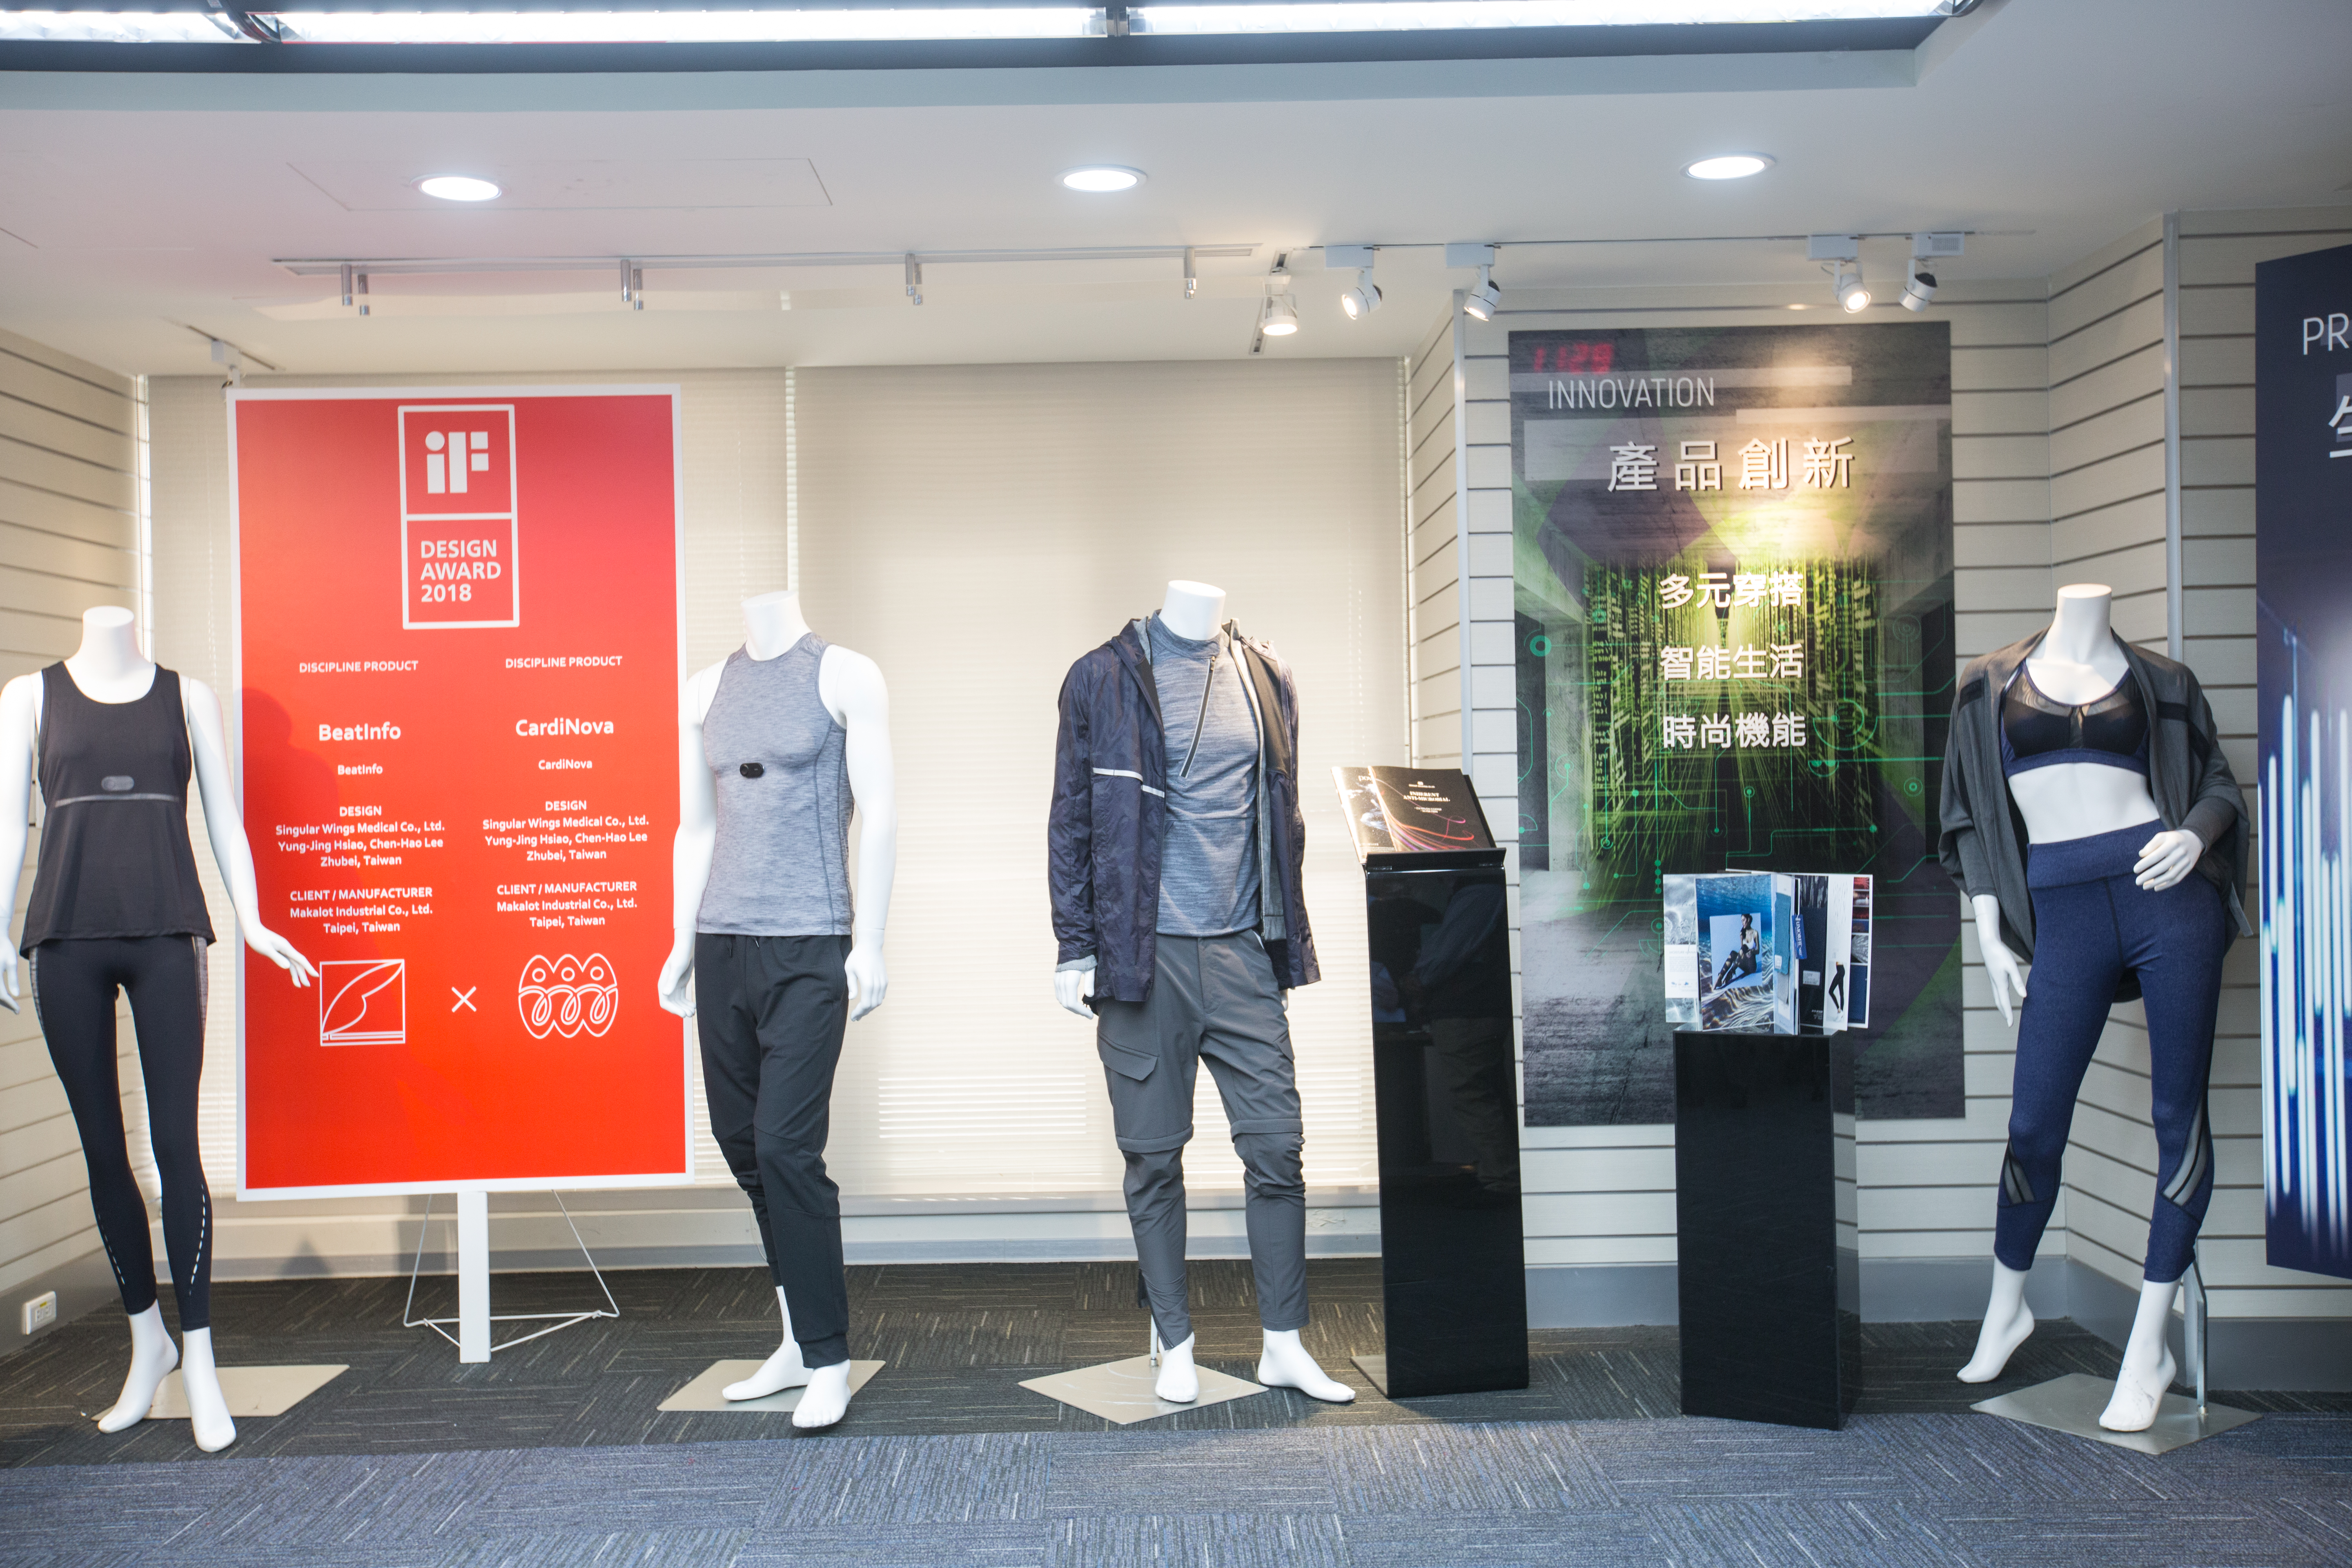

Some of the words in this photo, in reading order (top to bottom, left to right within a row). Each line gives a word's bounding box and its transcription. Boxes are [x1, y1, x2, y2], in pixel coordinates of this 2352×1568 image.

[2303, 312, 2350, 355] PR
[1549, 376, 1714, 409] INNOVATION
[1608, 436, 1854, 492] 產品創新
[421, 539, 497, 558] DESIGN
[420, 561, 501, 581] AWARD
[421, 584, 472, 603] 2018
[1659, 571, 1804, 610] 多元穿搭
[299, 662, 361, 673] DISCIPLINE
[364, 660, 419, 671] PRODUCT
[506, 657, 566, 668] DISCIPLINE
[569, 656, 623, 667] PRODUCT
[1659, 643, 1804, 681] 智能生活
[318, 721, 401, 741] BeatInfo
[515, 717, 614, 737] CardiNova
[1662, 711, 1807, 749] 時尚機能
[338, 763, 383, 775] BeatInfo
[538, 758, 592, 770] CardiNova
[340, 806, 382, 817] DESIGN
[546, 800, 587, 811] DESIGN
[276, 824, 319, 837] Singular
[322, 823, 355, 836] Wings
[357, 822, 397, 833] Medical
[400, 822, 421, 833] Co.,
[424, 820, 445, 831] Ltd.
[483, 819, 526, 832] Singular
[528, 817, 560, 831] Wings
[563, 816, 602, 828] Medical
[605, 816, 626, 828] Co.,
[628, 815, 649, 825] Ltd.
[278, 841, 331, 853] Yung-Jing
[334, 839, 367, 851] Hsiao,
[370, 838, 422, 849] Chen-Hao
[425, 838, 443, 847] Lee
[485, 835, 537, 848] Yung-Jing
[540, 833, 572, 846] Hsiao,
[575, 832, 626, 843] Chen-Hao
[629, 832, 648, 842] Lee
[321, 856, 361, 868] Zhubei,
[363, 855, 401, 865] Taiwan
[527, 850, 566, 862] Zhubei,
[569, 849, 606, 860] Taiwan
[290, 890, 330, 901] CLIENT
[339, 887, 432, 900] MANUFACTURER
[497, 884, 536, 895] CLIENT
[545, 881, 637, 894] MANUFACTURER
[290, 906, 333, 918] Makalot
[336, 905, 385, 916] Industrial
[388, 905, 409, 917] Co.,
[412, 903, 433, 914] Ltd.
[497, 900, 539, 911] Makalot
[542, 899, 590, 910] Industrial
[593, 899, 613, 911] Co.,
[617, 898, 637, 908] Ltd.
[323, 922, 359, 935] Taipei,
[362, 921, 400, 932] Taiwan
[529, 916, 564, 929] Taipei,
[568, 915, 605, 926] Taiwan
